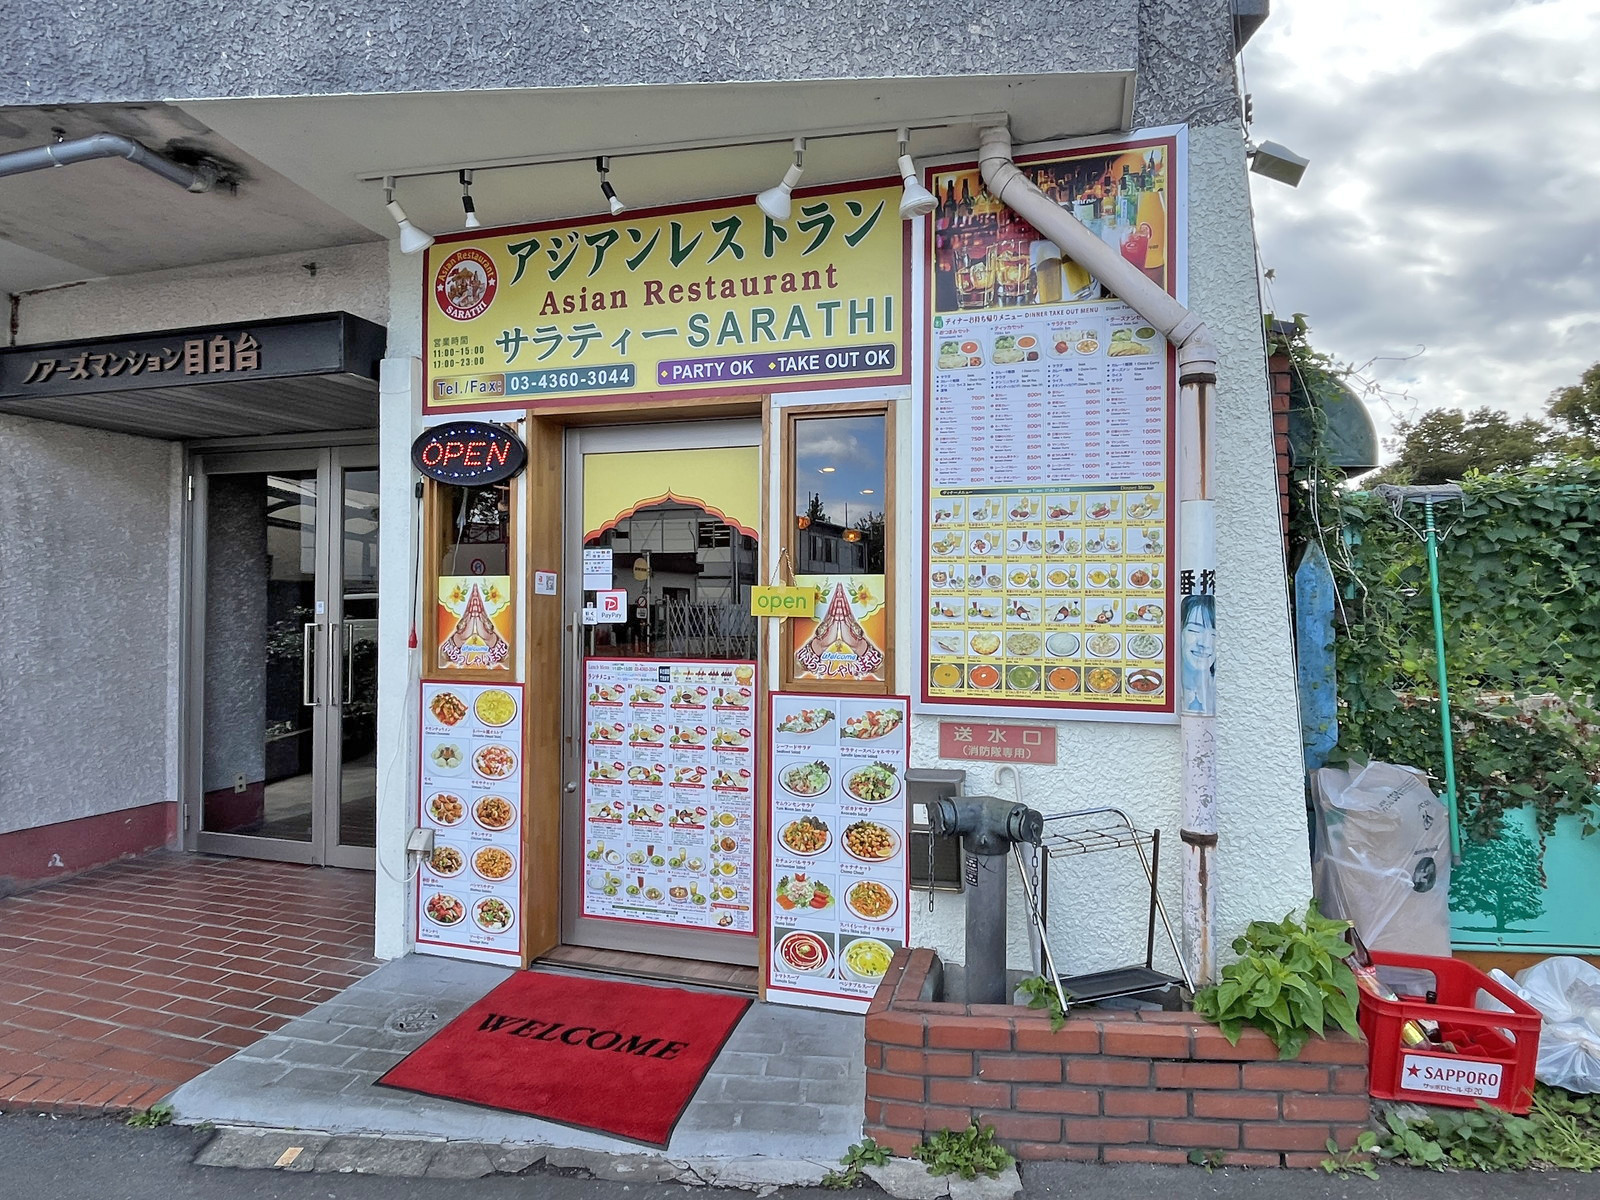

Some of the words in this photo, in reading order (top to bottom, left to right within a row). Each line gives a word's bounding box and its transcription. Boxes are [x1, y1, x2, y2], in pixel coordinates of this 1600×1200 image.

[507, 200, 886, 286] アジアンレストラン
[437, 258, 456, 281] Asian
[457, 250, 494, 278] Restaurant
[539, 285, 628, 316] Asian
[643, 262, 839, 306] Restaurant
[445, 301, 487, 320] SARATHI
[433, 335, 469, 348] 営業時間
[495, 321, 680, 365] サラティー
[686, 295, 894, 349] SARATHI
[672, 362, 725, 380] PARTY
[729, 360, 754, 376] OK
[777, 355, 820, 372] TAKE
[825, 351, 859, 368] OUT
[864, 348, 891, 366] OK
[510, 368, 630, 391] 03-4360-3044
[422, 441, 511, 466] OPEN
[757, 594, 807, 613] open
[796, 646, 881, 677] いらっしゃいませ
[953, 726, 1042, 746] 送水口
[962, 744, 1032, 760] （消防隊専用）
[840, 805, 873, 813] アボカドサラダ
[477, 1013, 690, 1060] WELCOME
[1423, 1083, 1464, 1093] サッポロビール
[1424, 1066, 1499, 1087] SAPPORO
